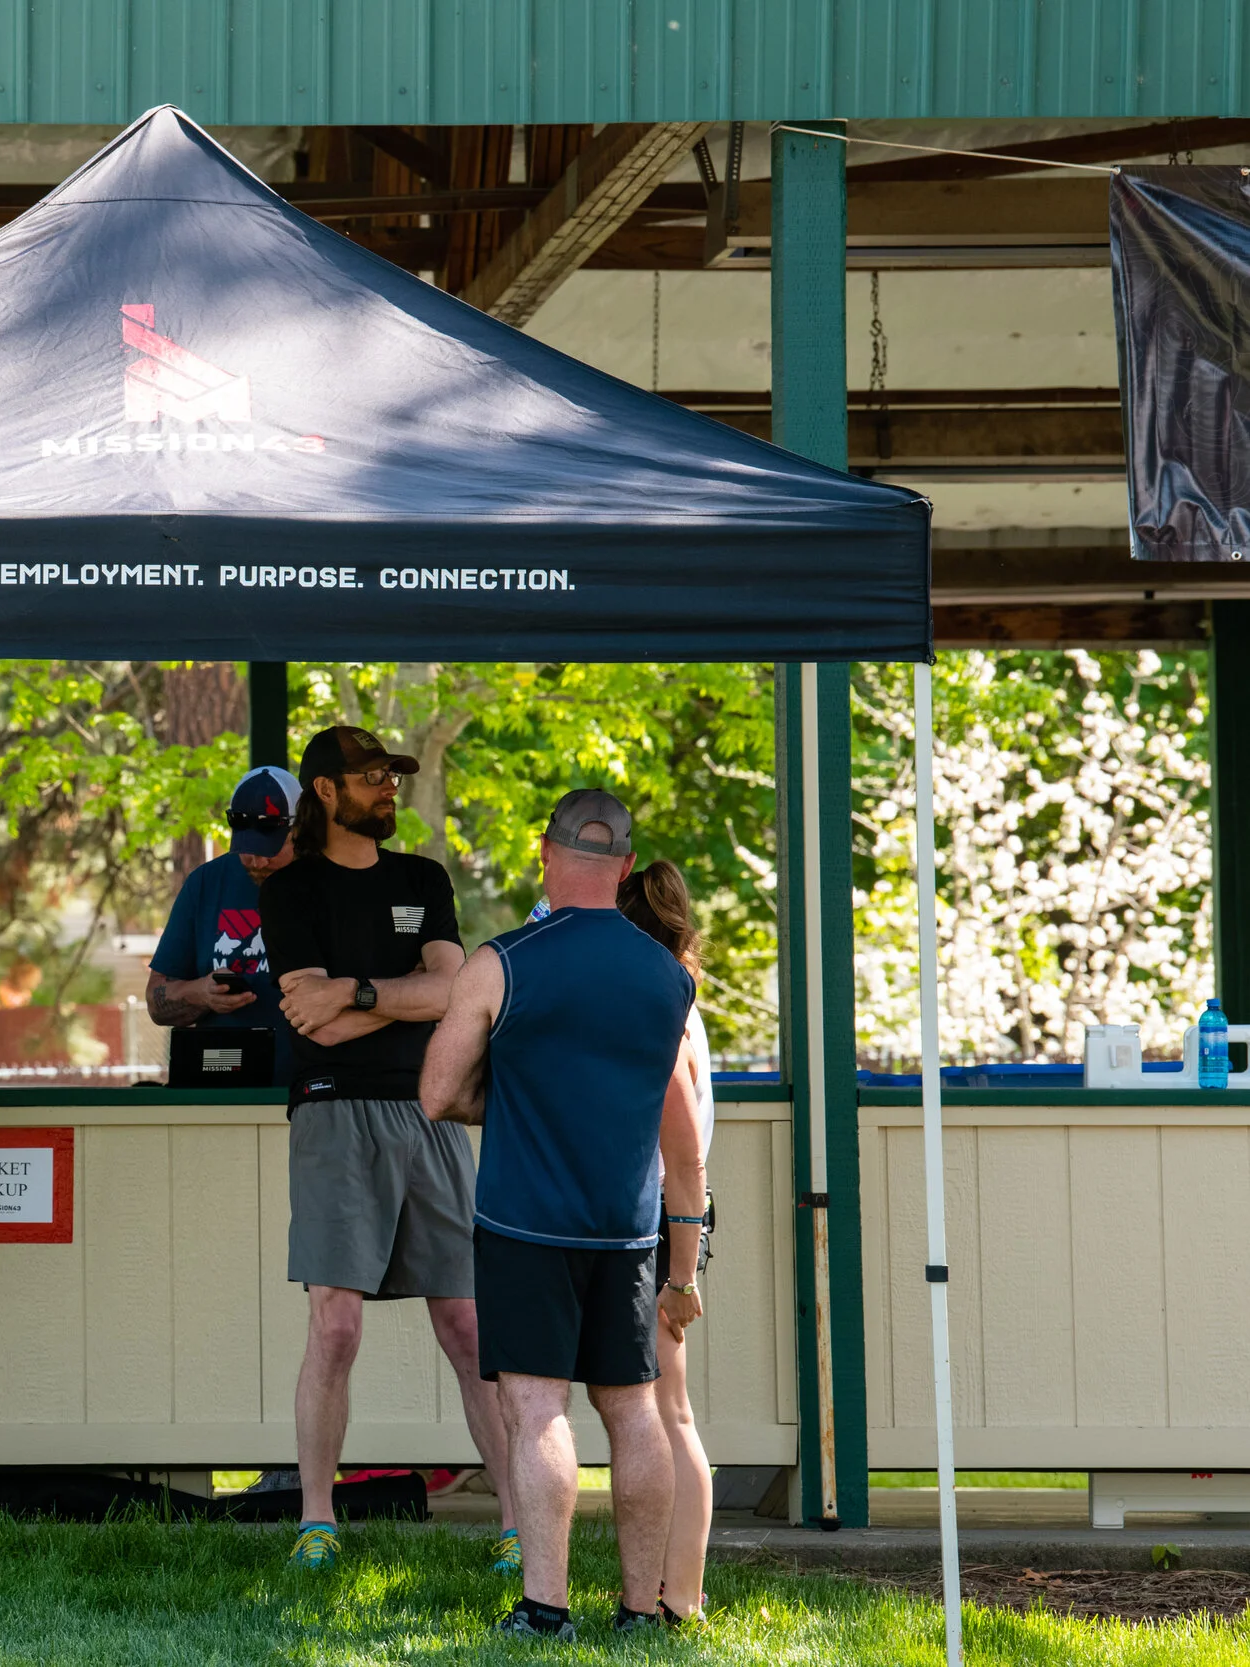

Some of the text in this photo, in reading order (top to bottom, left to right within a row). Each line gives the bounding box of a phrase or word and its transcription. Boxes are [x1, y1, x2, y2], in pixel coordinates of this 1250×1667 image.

[41, 433, 326, 458] MISSION43
[0, 563, 204, 586] EMPLOYMENT.
[219, 565, 364, 589] PURPOSE.
[379, 567, 575, 591] CONNECTION.
